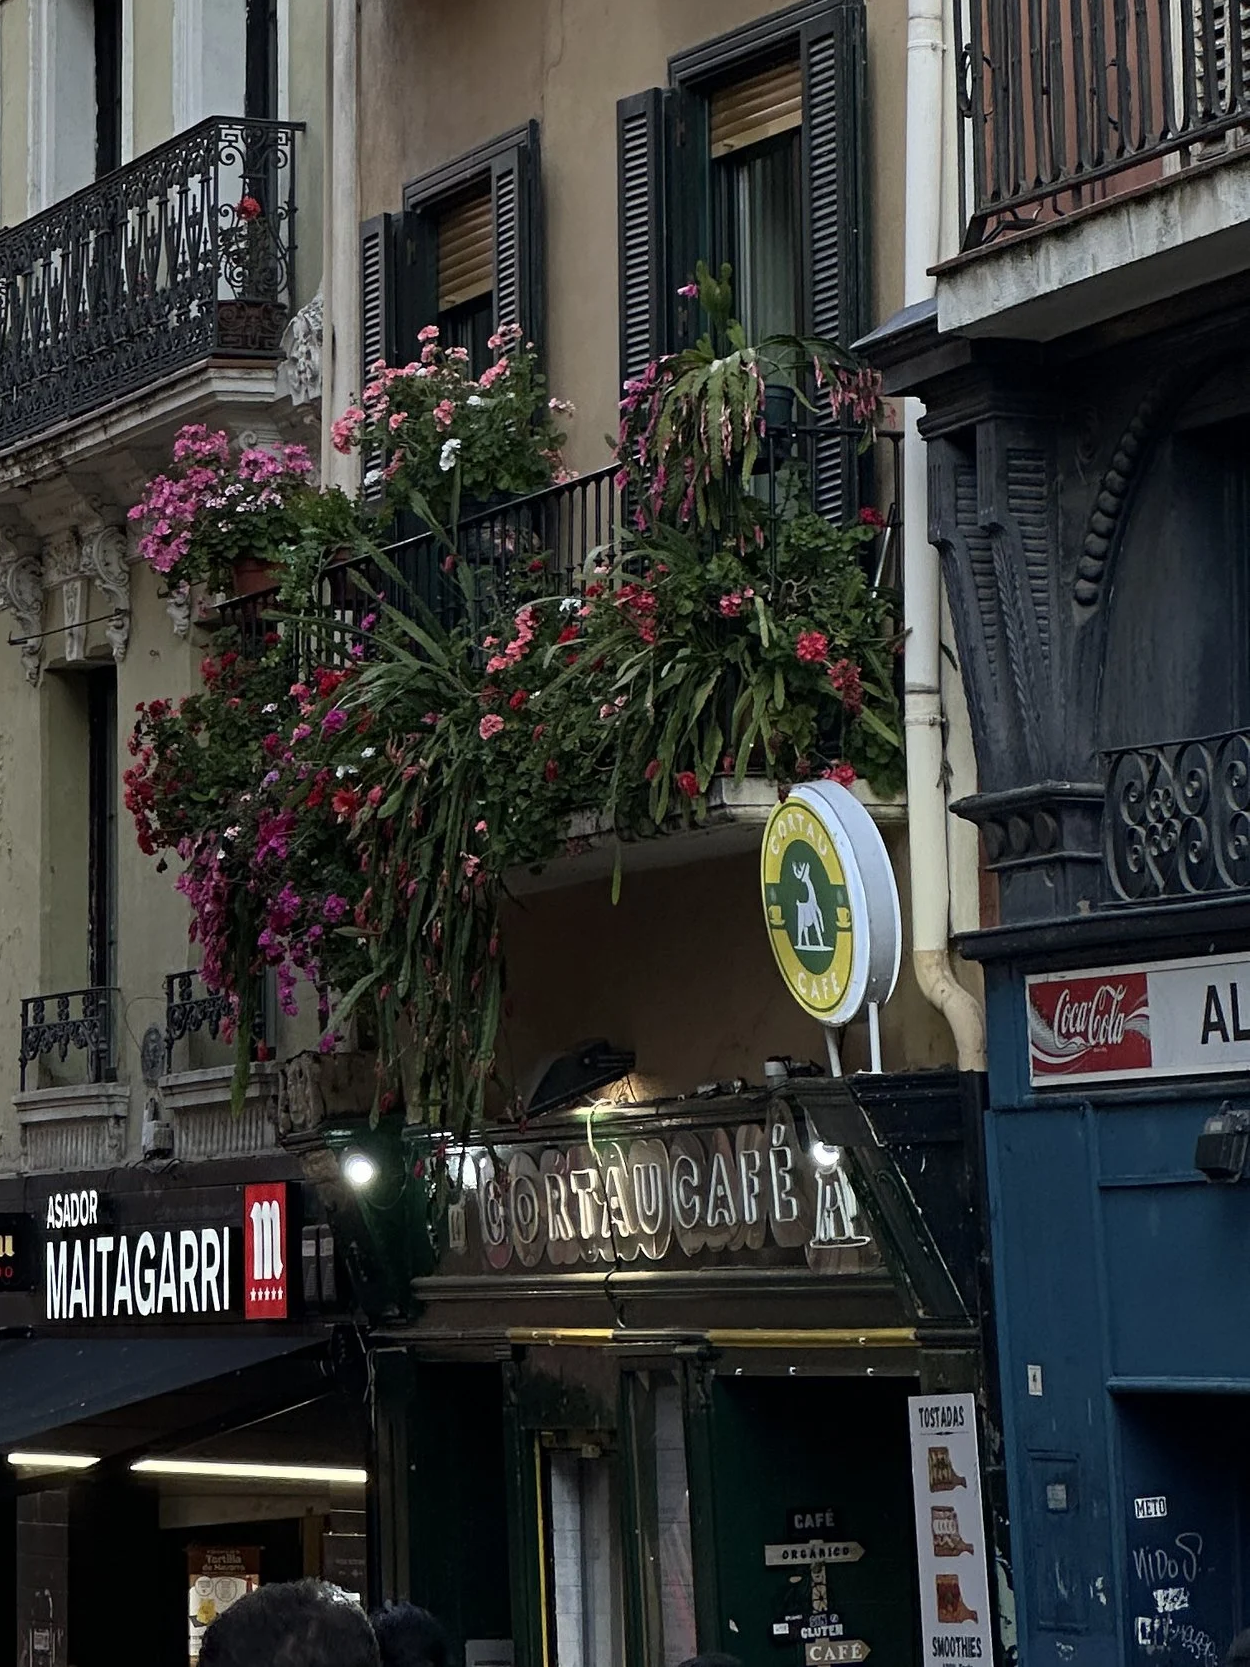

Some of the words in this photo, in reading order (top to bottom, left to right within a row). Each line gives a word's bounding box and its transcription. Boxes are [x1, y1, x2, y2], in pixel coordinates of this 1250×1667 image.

[46, 1189, 98, 1229] ASADOR
[46, 1226, 230, 1320] MAITAGARRI
[918, 1405, 965, 1428] TOSTADAS
[794, 1508, 836, 1529] CAFÉ
[809, 1642, 863, 1662] CAFÉ
[932, 1636, 983, 1659] SMOOTHIES
